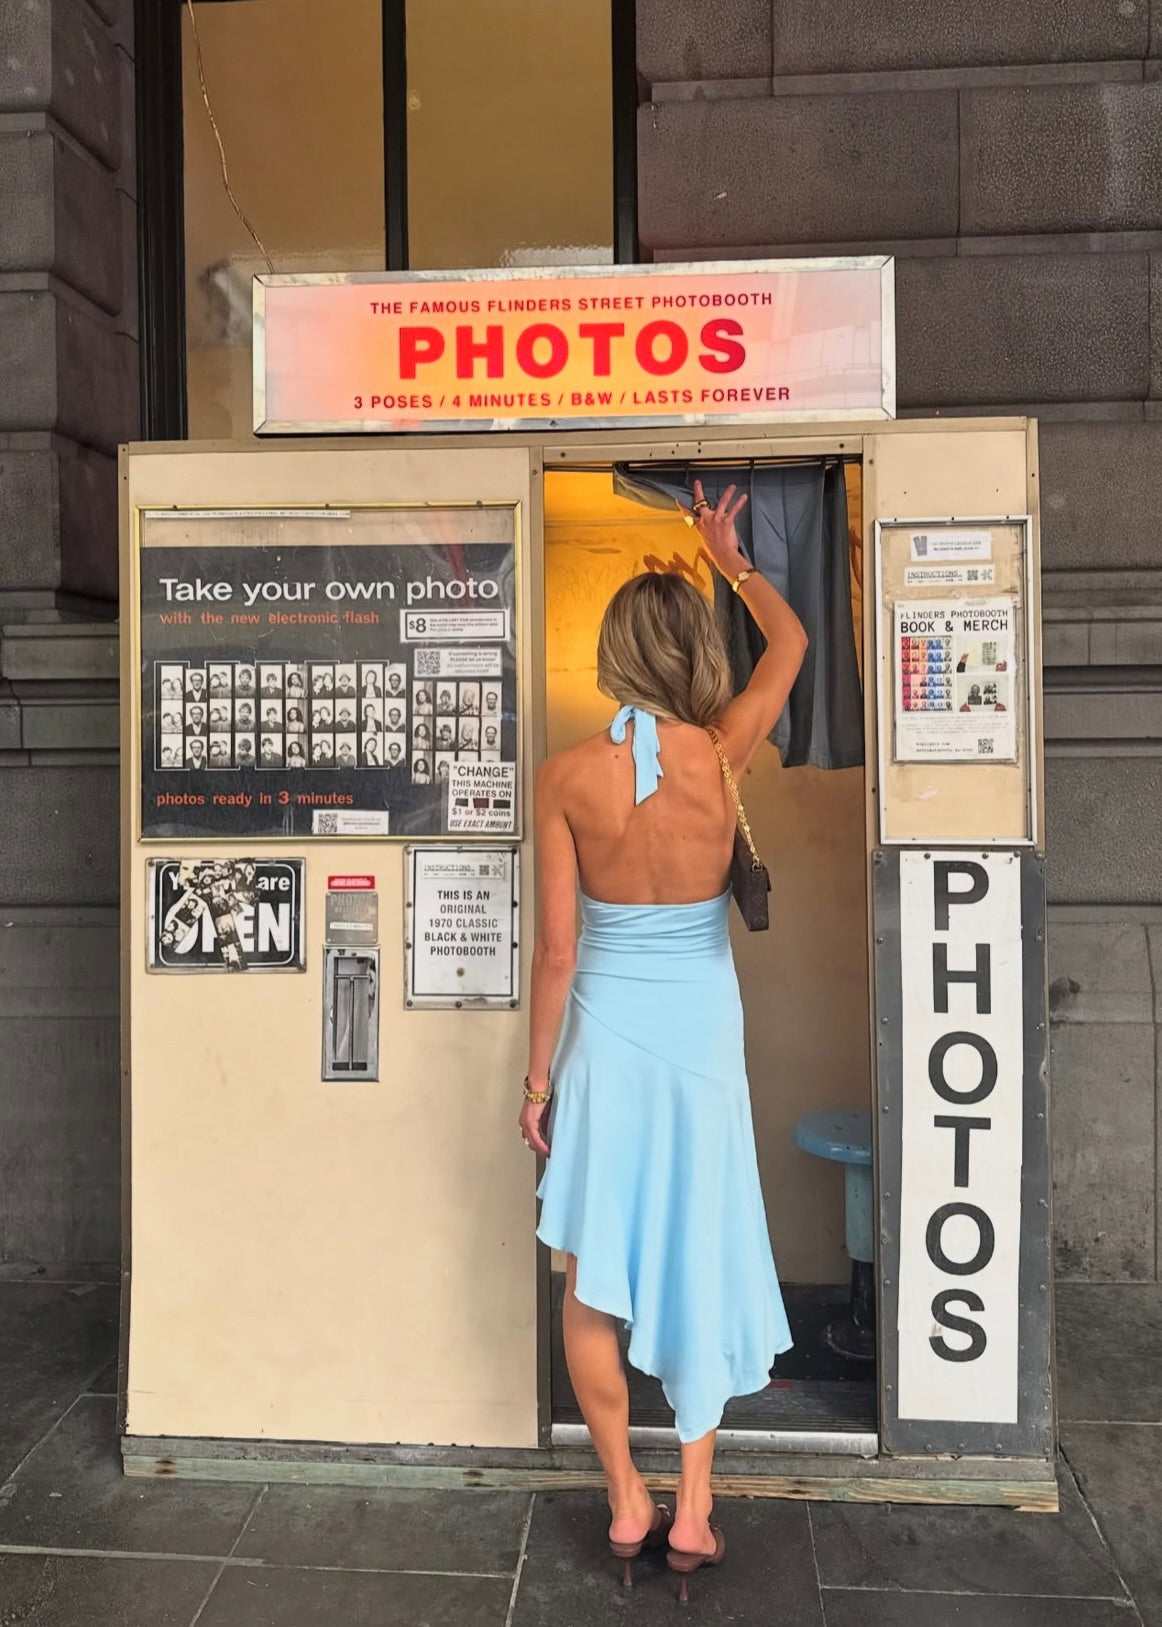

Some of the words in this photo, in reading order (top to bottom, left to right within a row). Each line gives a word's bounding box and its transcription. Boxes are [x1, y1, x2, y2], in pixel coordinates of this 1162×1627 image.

[370, 302, 402, 314] THE
[410, 300, 480, 313] FAMOUS
[488, 299, 571, 312] FLINDERS
[578, 296, 645, 310] STREET
[652, 293, 772, 308] PHOTOBOOTH
[399, 318, 746, 380] PHOTOS
[354, 396, 363, 409] 3
[371, 395, 433, 408] POSES
[452, 395, 461, 407] 4
[469, 393, 551, 407] MINUTES
[571, 391, 613, 406] B&W
[633, 389, 693, 404] LASTS
[701, 387, 790, 402] FOREVER
[159, 578, 233, 601] Take
[242, 581, 316, 606] your
[325, 581, 395, 600] own
[407, 576, 499, 605] photo
[160, 611, 192, 624] with
[201, 610, 223, 624] the
[231, 613, 260, 624] new
[268, 610, 338, 624] electronic
[345, 610, 379, 624] flash
[900, 611, 945, 619] FLINDERS
[951, 609, 1008, 618] PHOTOBOOTH
[409, 618, 427, 633] $8
[900, 621, 935, 633] BOOK
[945, 620, 953, 632] &
[963, 619, 1008, 632] MERCH
[452, 779, 471, 787] THIS
[473, 780, 513, 789] MACHINE
[156, 792, 205, 807] photos
[213, 792, 252, 807] ready
[260, 792, 272, 804] in
[278, 791, 290, 805] 3
[297, 792, 354, 804] minutes
[451, 789, 497, 797] OPERATES
[499, 790, 512, 798] ON
[485, 820, 512, 829] AMOUNT
[257, 876, 291, 891] are
[437, 890, 460, 900] THIS
[463, 890, 473, 900] IS
[476, 890, 490, 900] AN
[440, 904, 487, 914] ORIGINAL
[429, 918, 453, 928] 1970
[456, 918, 498, 928] CLASSIC
[424, 932, 457, 942] BLACK
[460, 932, 467, 942] &
[471, 932, 502, 942] WHITE
[430, 946, 496, 956] PHOTOBOOTH
[925, 860, 998, 1362] PHOTOS
